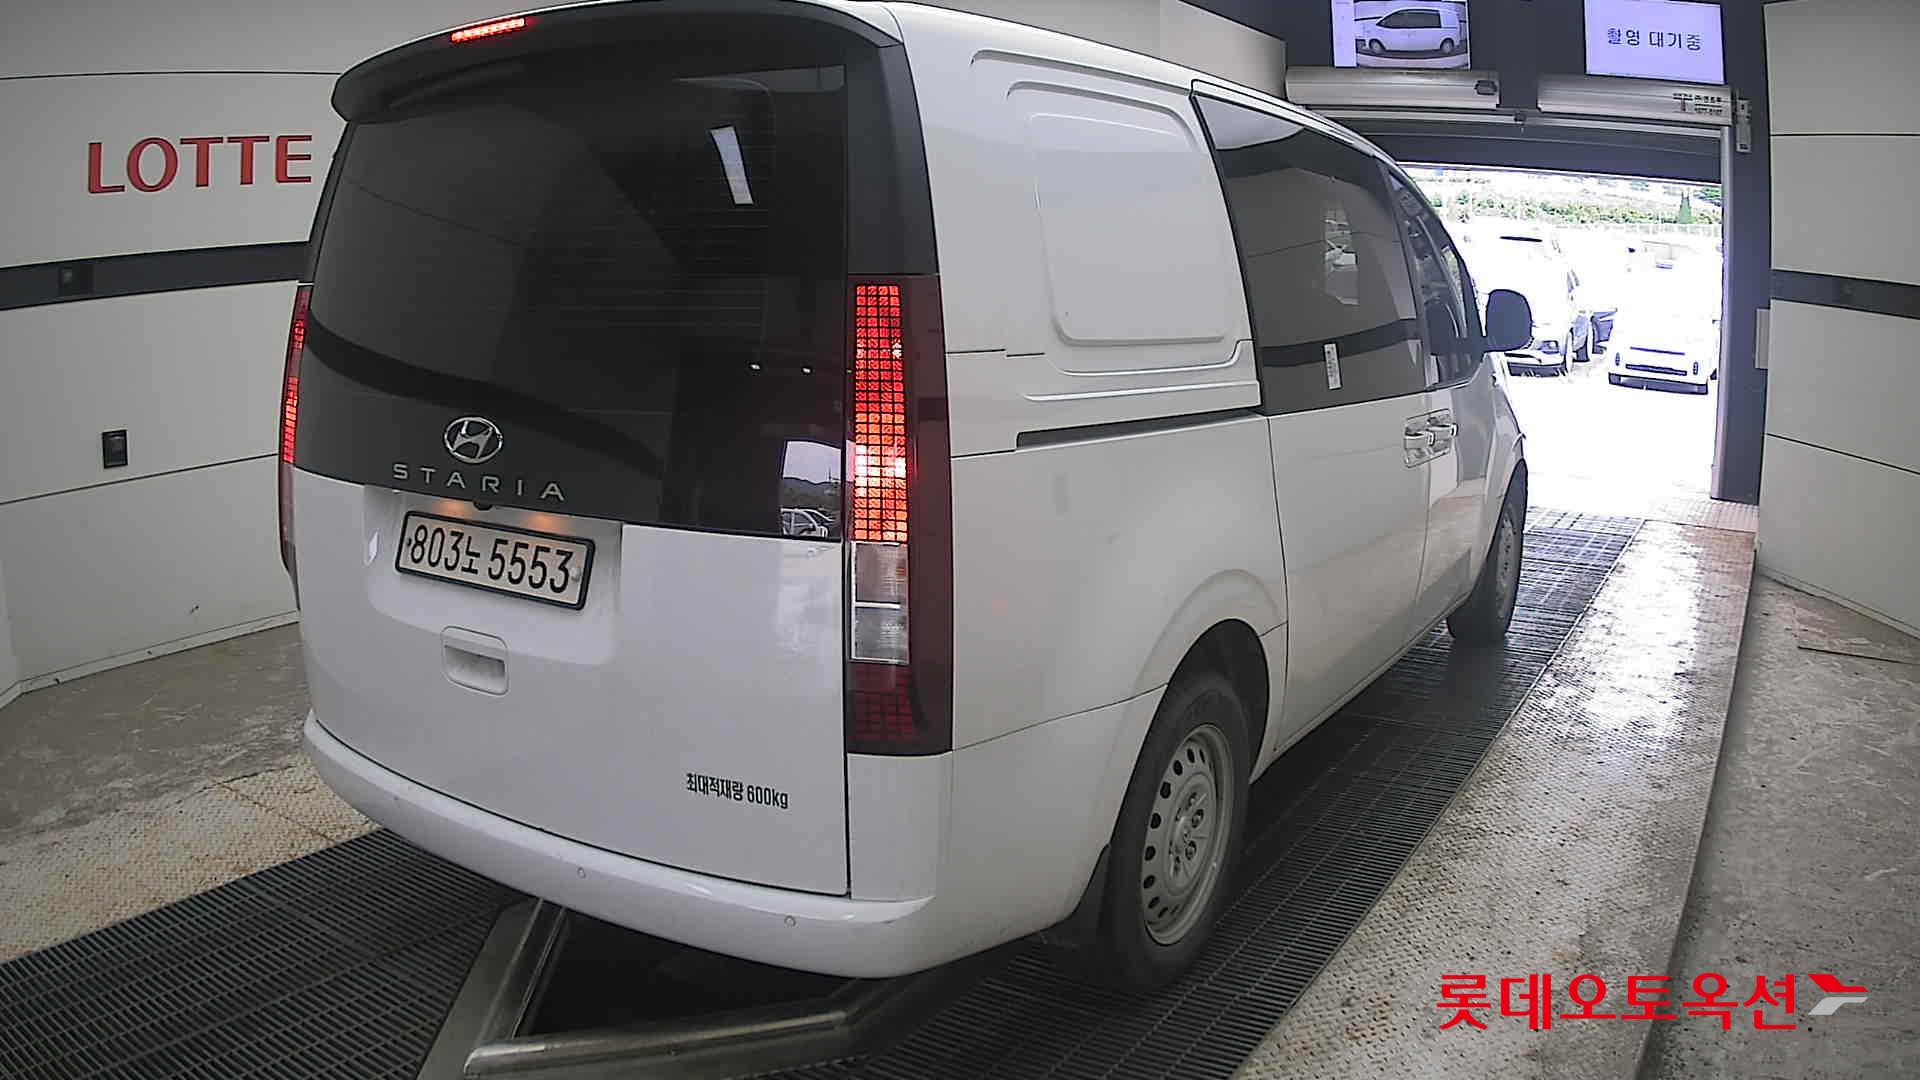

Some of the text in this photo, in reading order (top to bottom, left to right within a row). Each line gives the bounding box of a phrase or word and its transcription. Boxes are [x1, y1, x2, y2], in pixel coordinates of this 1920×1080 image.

[88, 135, 313, 194] LOTTE
[393, 463, 565, 501] STARIA
[487, 538, 574, 593] 5553
[686, 772, 789, 809] 최대적재량 600kg
